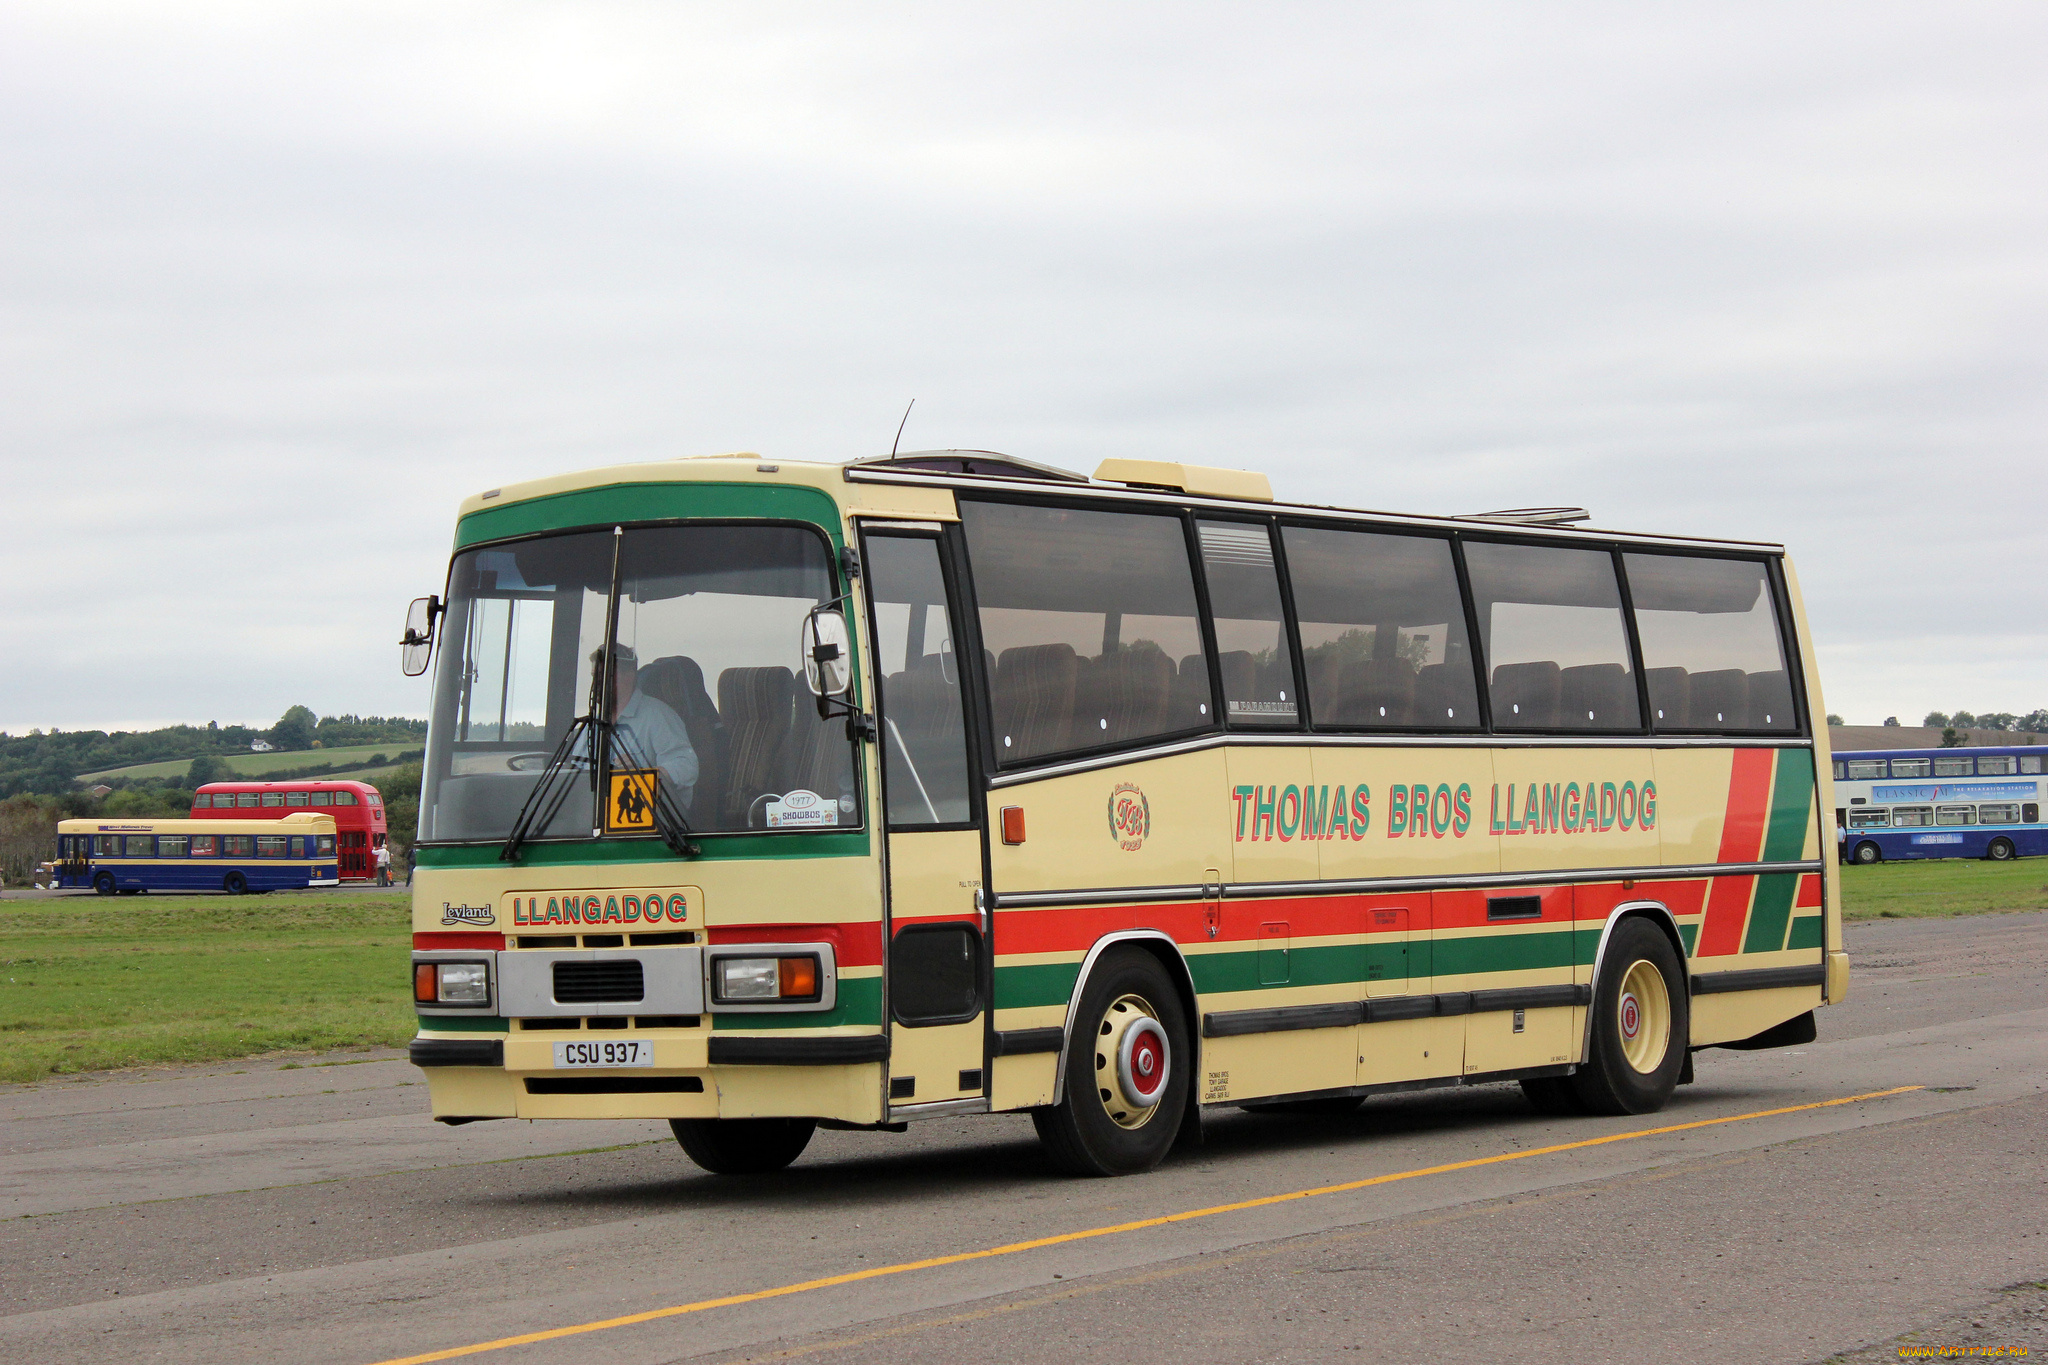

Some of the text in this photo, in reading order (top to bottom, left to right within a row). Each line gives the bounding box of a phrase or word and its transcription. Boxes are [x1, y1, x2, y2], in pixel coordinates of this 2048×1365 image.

[1240, 701, 1295, 712] PARAMOUNT
[791, 796, 811, 805] 1977
[1876, 789, 1925, 799] CLASSIC
[782, 810, 821, 820] SHOWBUS
[1232, 779, 1658, 842] THOMAS BROS LLANGADOG
[440, 902, 496, 926] Leyland
[513, 893, 687, 927] LLANGADOG
[565, 1042, 639, 1064] CSU 937
